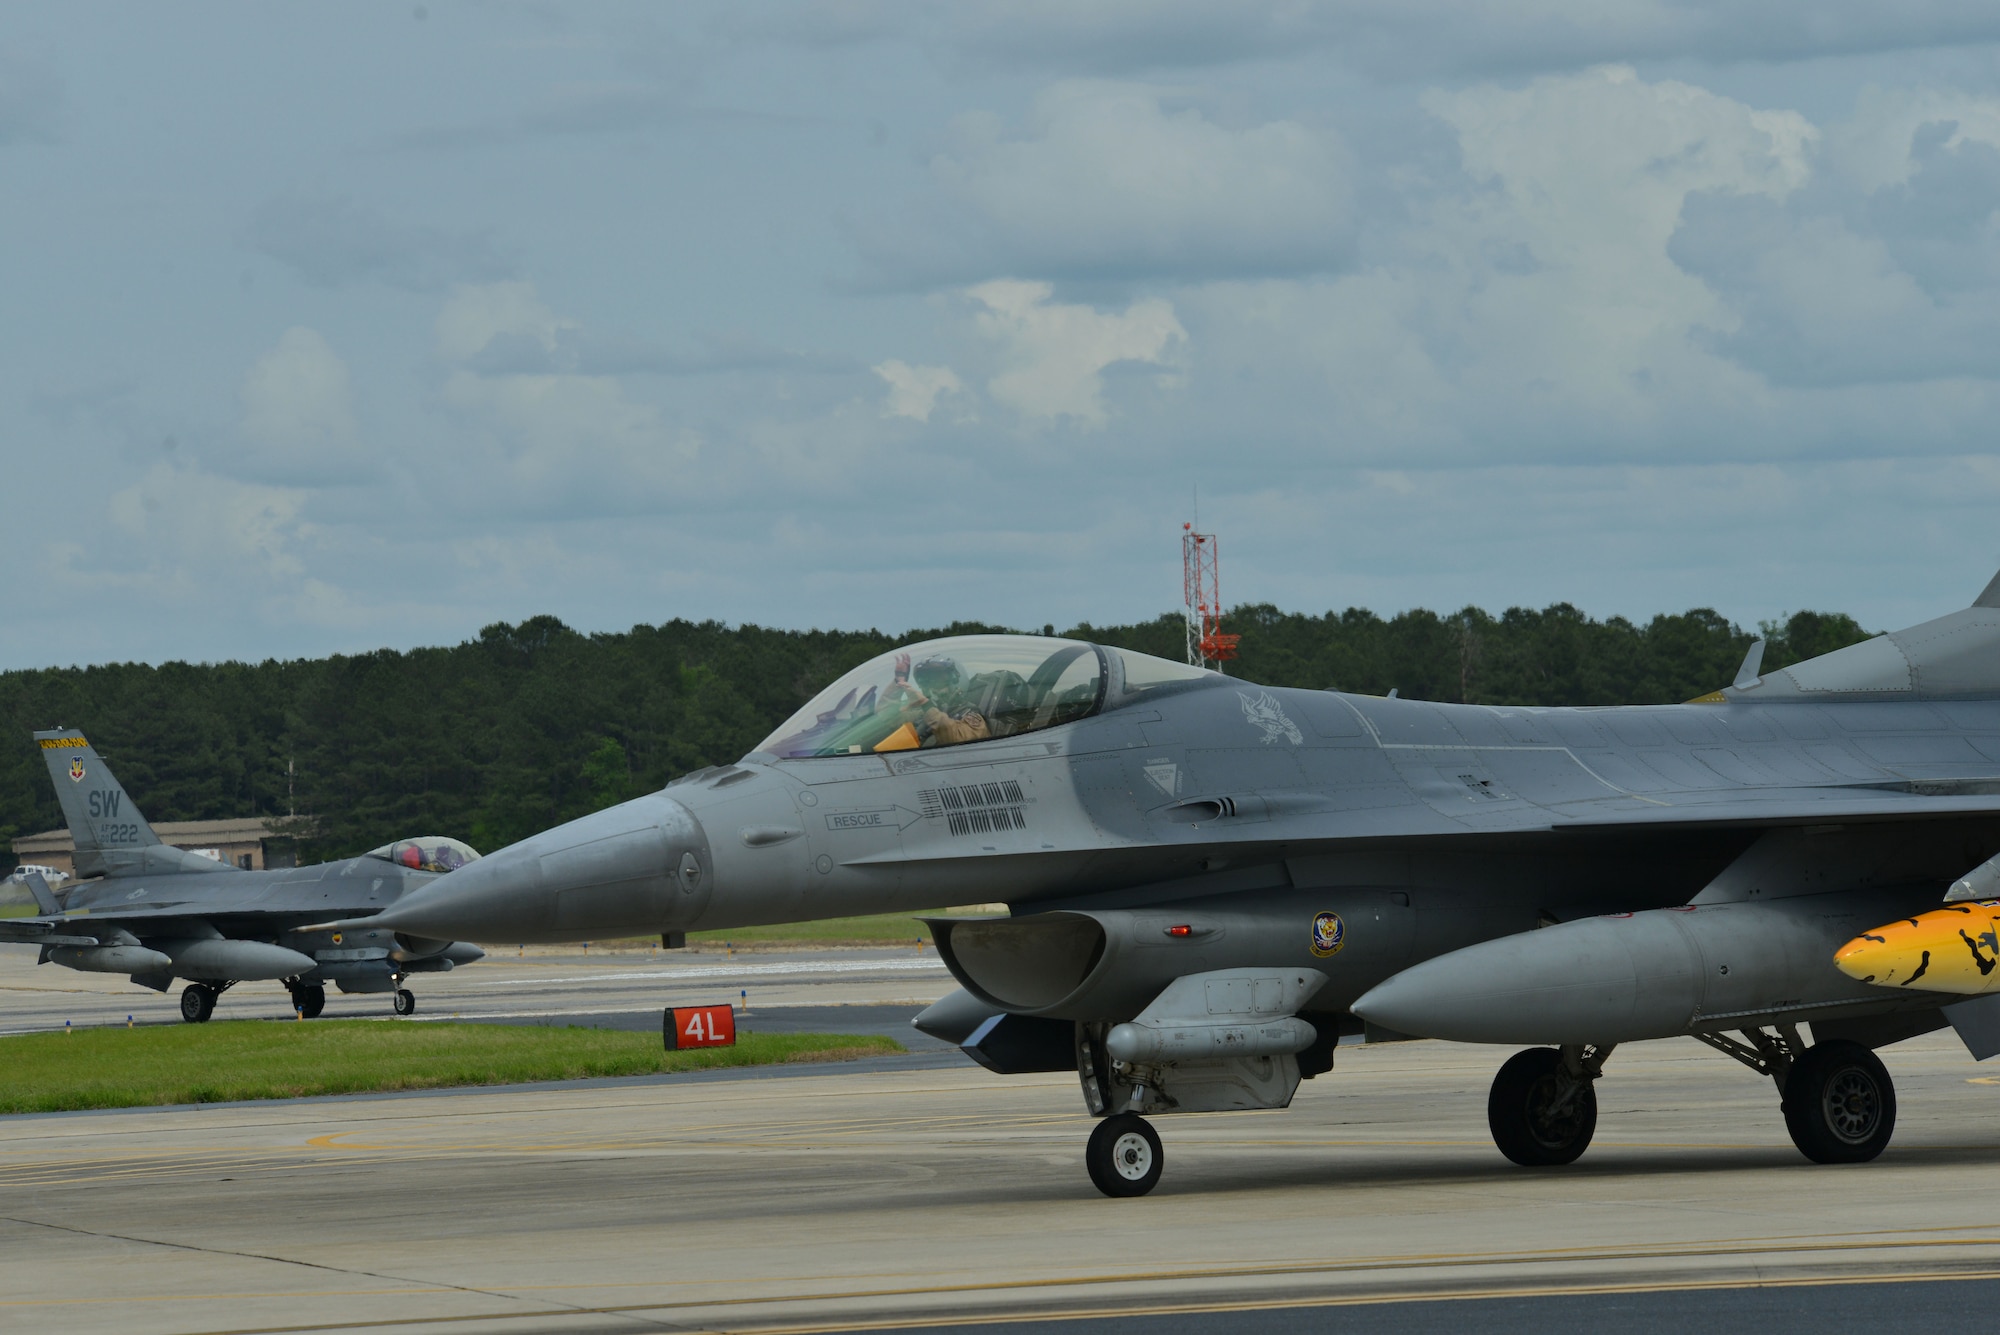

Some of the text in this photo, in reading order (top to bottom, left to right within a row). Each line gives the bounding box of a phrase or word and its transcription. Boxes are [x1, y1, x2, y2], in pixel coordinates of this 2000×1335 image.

[89, 790, 121, 818] SW
[833, 813, 882, 828] RESCUE
[110, 824, 138, 843] 222
[685, 1011, 726, 1042] 4L
